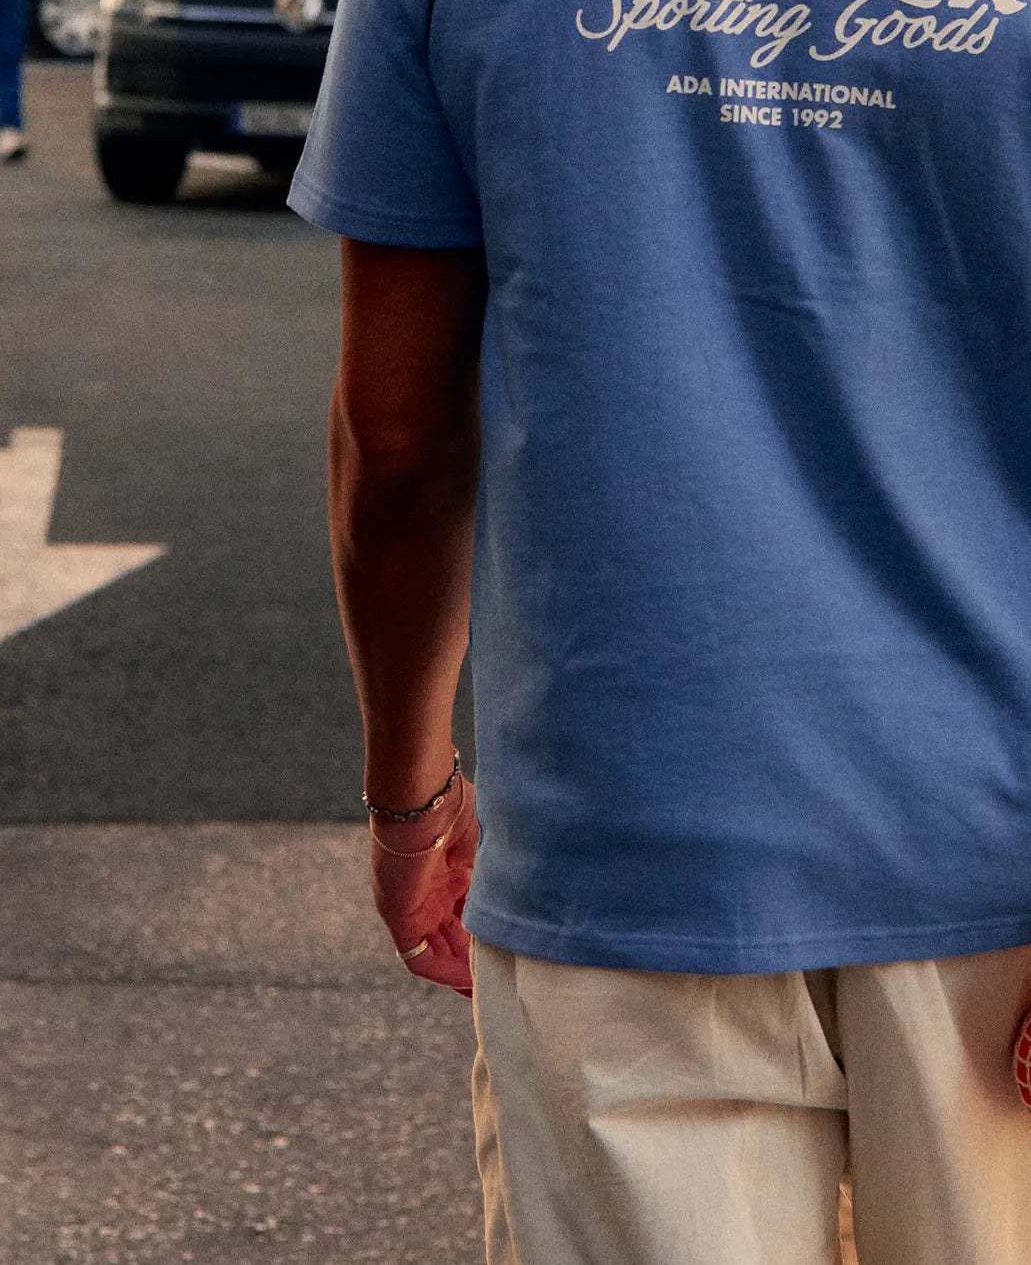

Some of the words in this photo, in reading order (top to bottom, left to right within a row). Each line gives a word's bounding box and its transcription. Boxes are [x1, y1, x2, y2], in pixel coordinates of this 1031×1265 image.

[666, 74, 713, 96] ADA
[719, 77, 897, 110] INTERNATIONAL
[720, 103, 783, 127] SINCE
[792, 107, 844, 129] 1992
